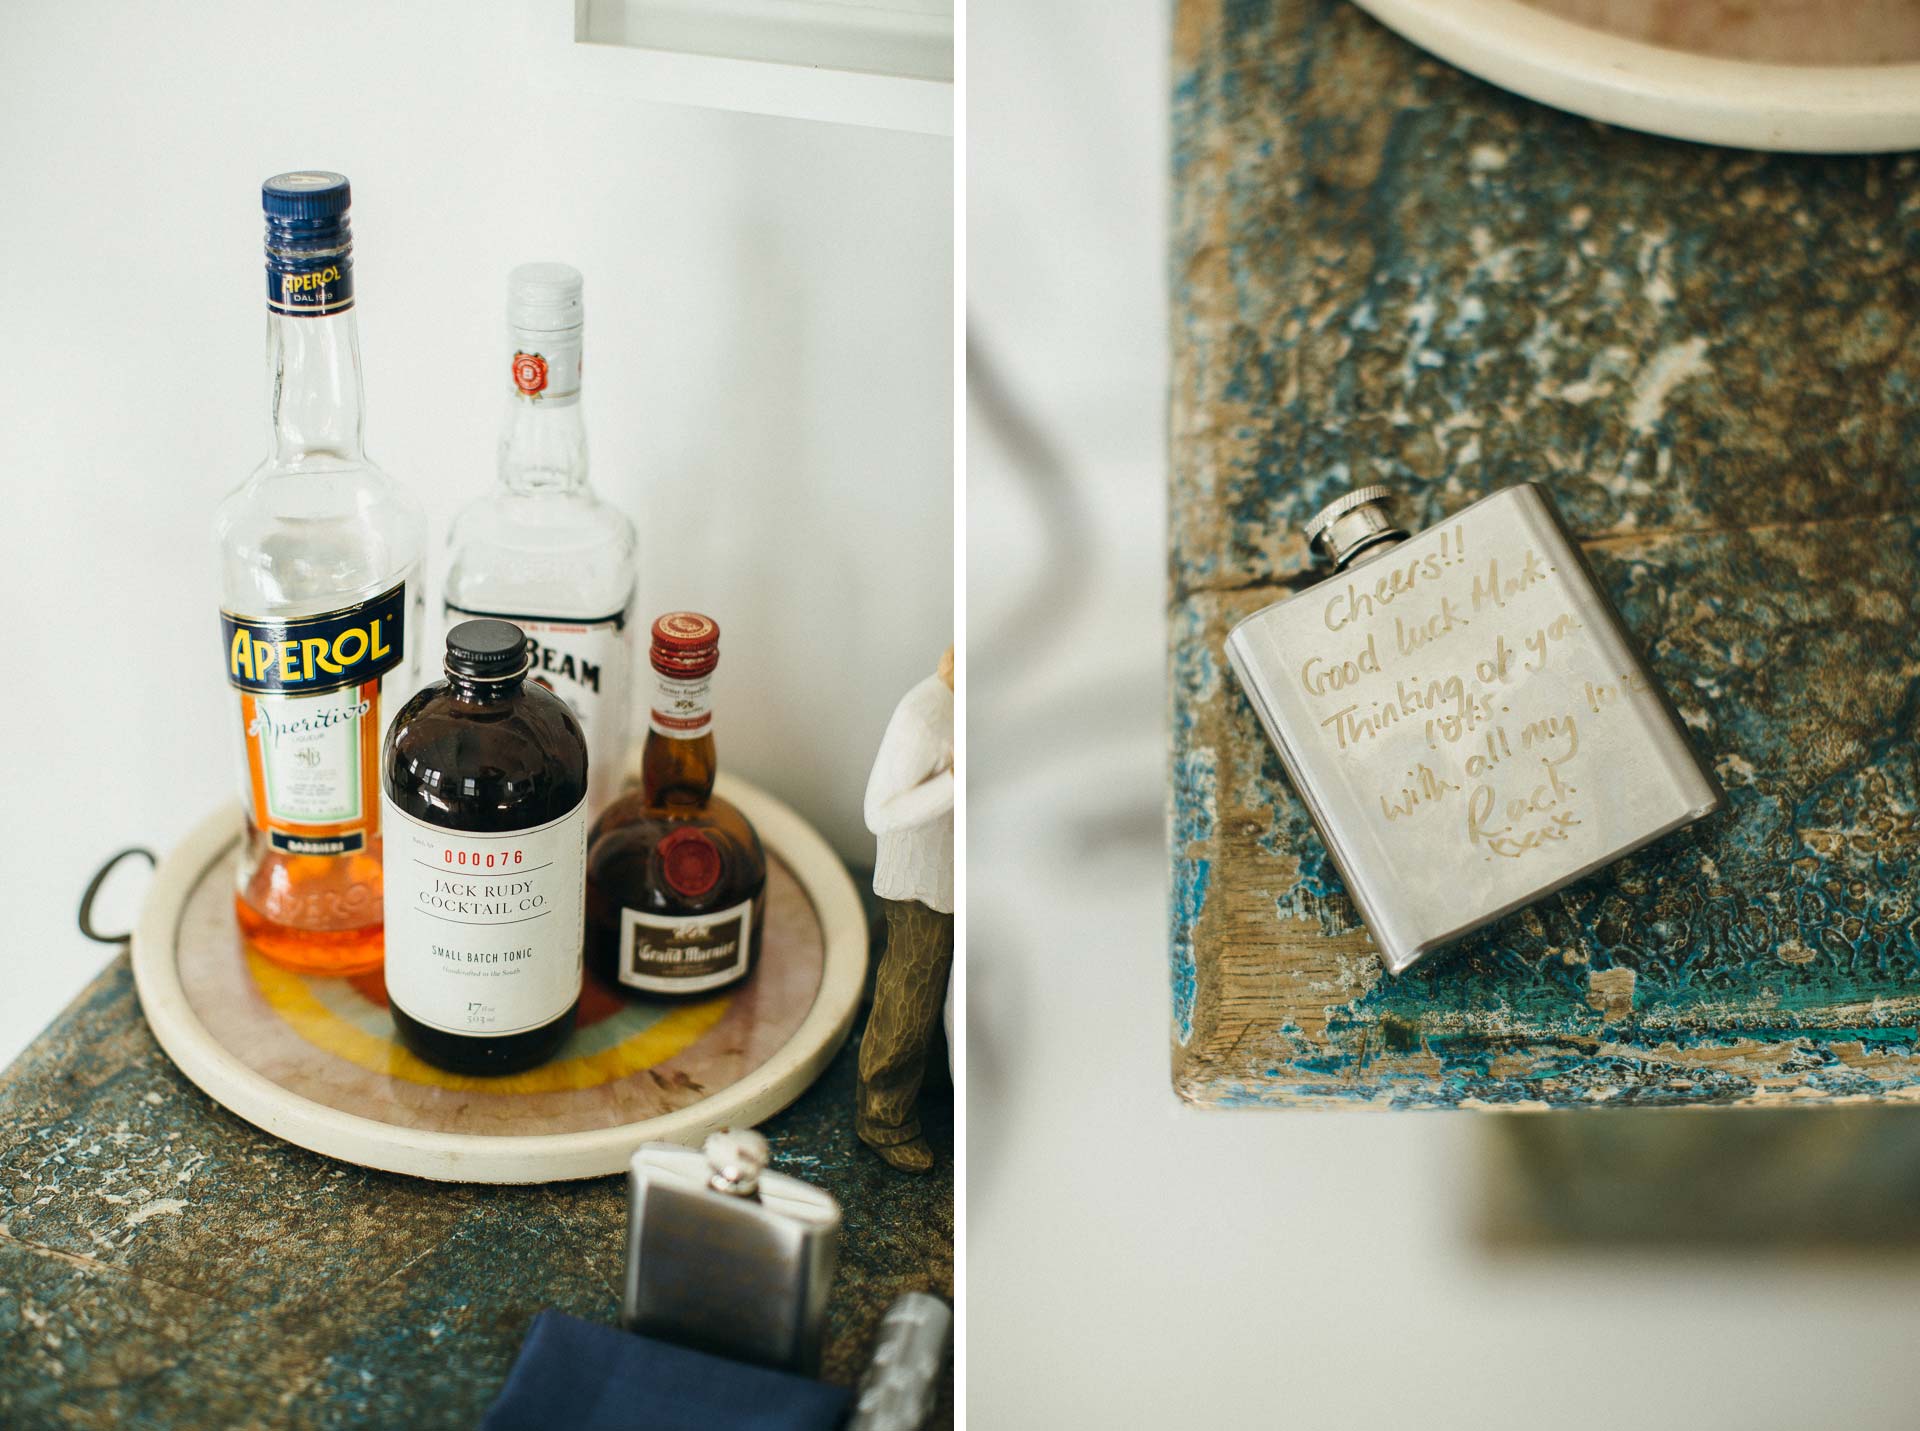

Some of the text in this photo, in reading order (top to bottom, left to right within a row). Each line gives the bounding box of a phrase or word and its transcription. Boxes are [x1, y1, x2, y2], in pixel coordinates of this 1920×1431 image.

[294, 294, 314, 302] DAL
[1324, 524, 1465, 632] Cheers!!
[231, 618, 391, 682] APEROL
[1302, 633, 1381, 697] Good
[250, 701, 368, 748] Aperitivo
[1321, 674, 1465, 749] Thinking
[1464, 726, 1512, 778] all
[444, 849, 523, 868] 000076
[419, 891, 547, 915] COCKTAIL CO.
[434, 879, 534, 898] JACK RUDY
[431, 945, 533, 964] SMALL BATCH TONIC
[467, 1001, 482, 1017] 17
